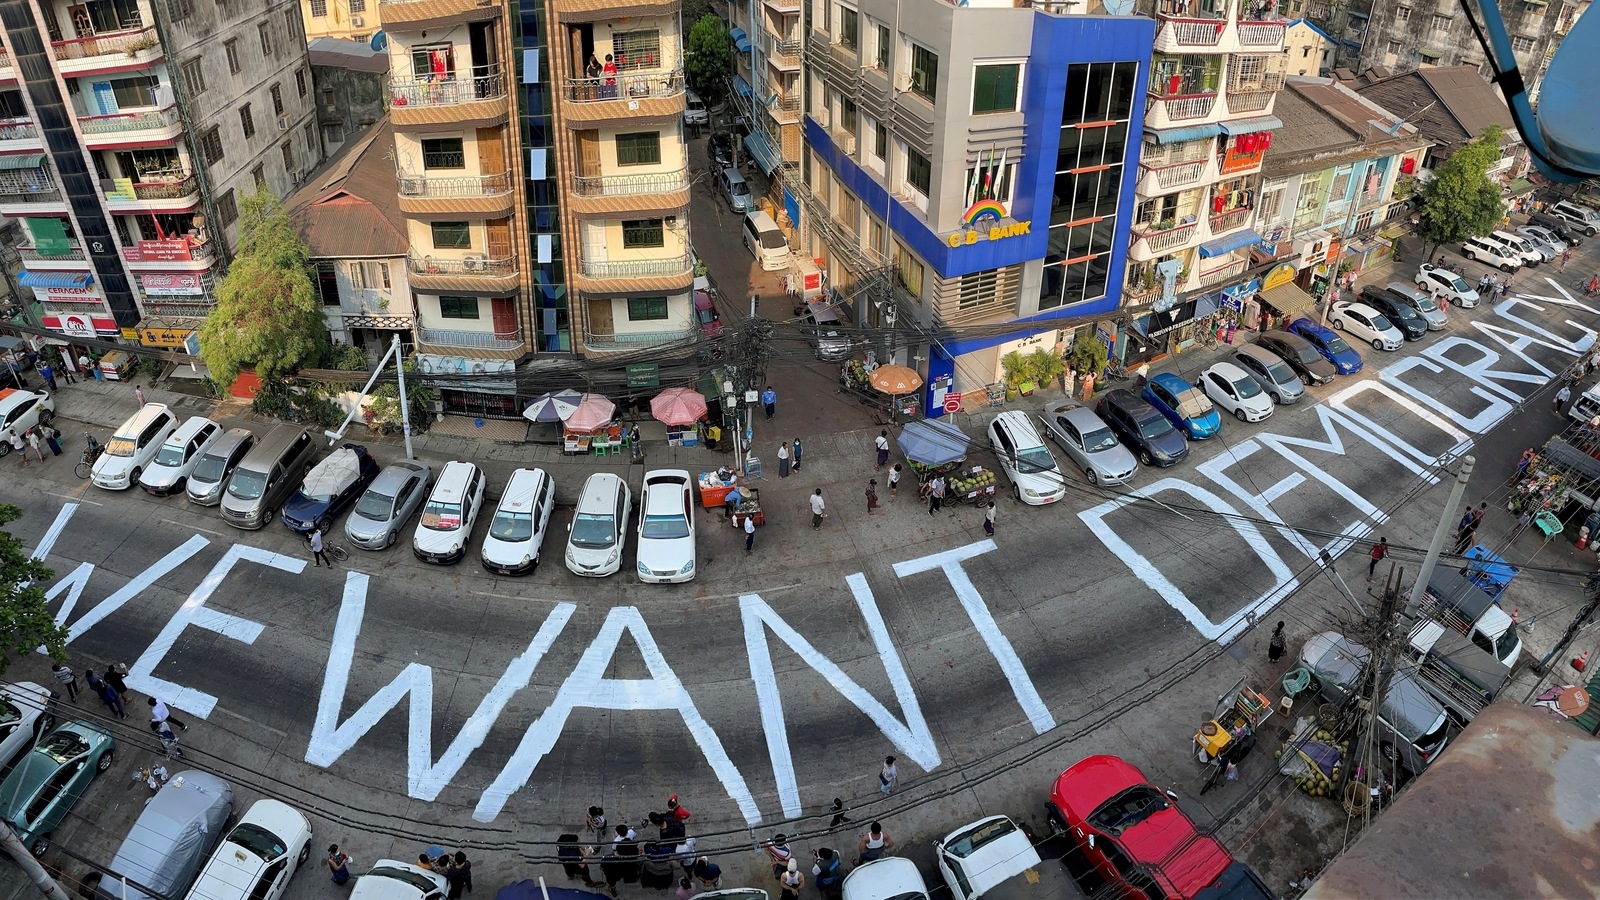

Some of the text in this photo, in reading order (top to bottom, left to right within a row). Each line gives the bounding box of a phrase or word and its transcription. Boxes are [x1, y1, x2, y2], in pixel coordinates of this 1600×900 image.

[989, 221, 1031, 240] BANK
[47, 287, 87, 295] CERAGEM
[66, 320, 87, 332] City
[5, 276, 1600, 837] WE WANT DEMOCRACY
